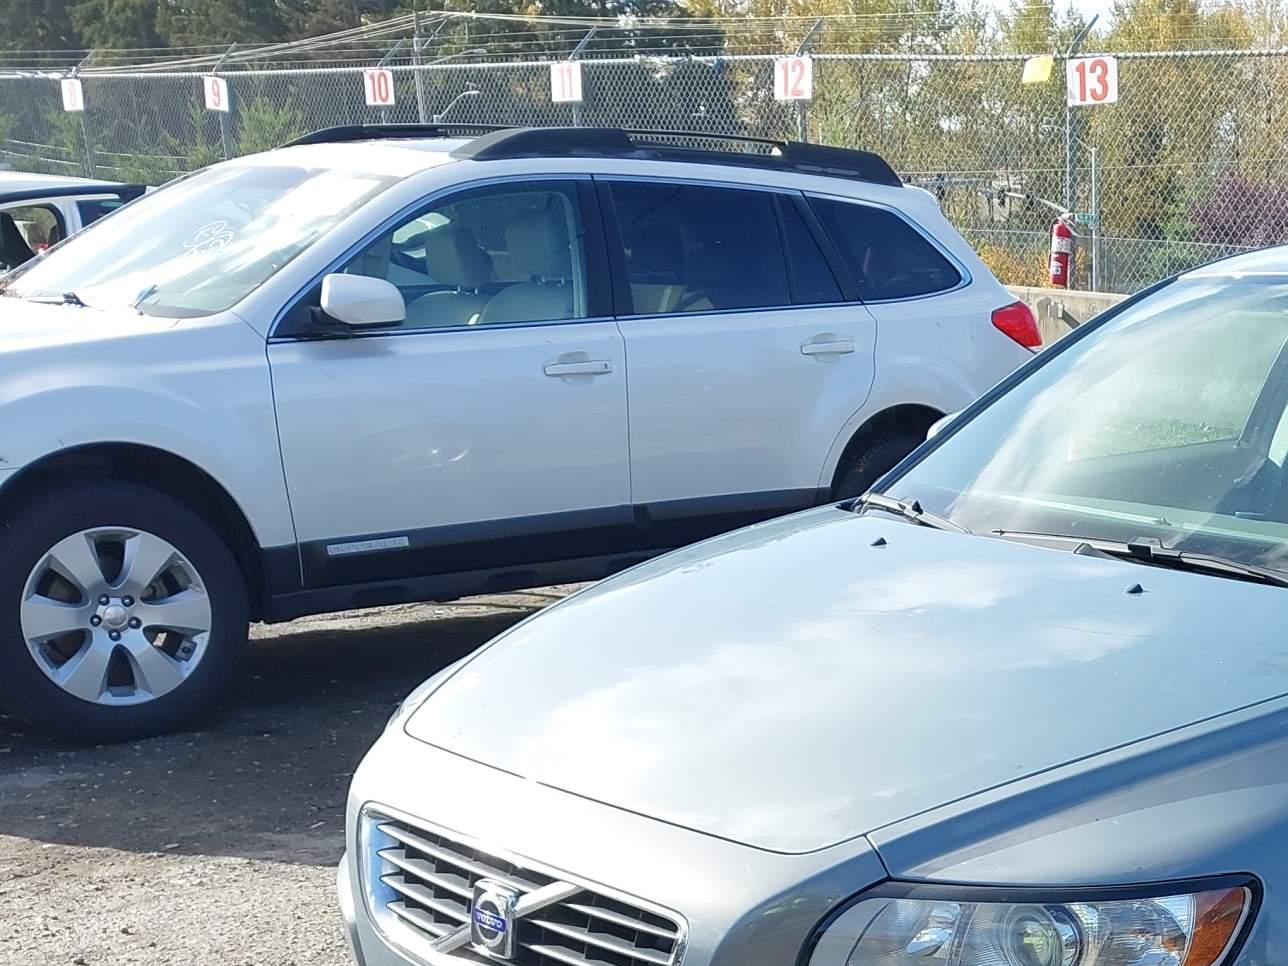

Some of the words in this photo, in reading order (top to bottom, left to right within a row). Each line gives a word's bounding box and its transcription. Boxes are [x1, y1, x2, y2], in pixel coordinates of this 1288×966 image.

[211, 78, 221, 107] 9
[369, 71, 389, 103] 10
[558, 64, 574, 99] 11
[781, 59, 805, 97] 12
[1075, 58, 1109, 102] 13
[476, 912, 503, 929] VOLVO
